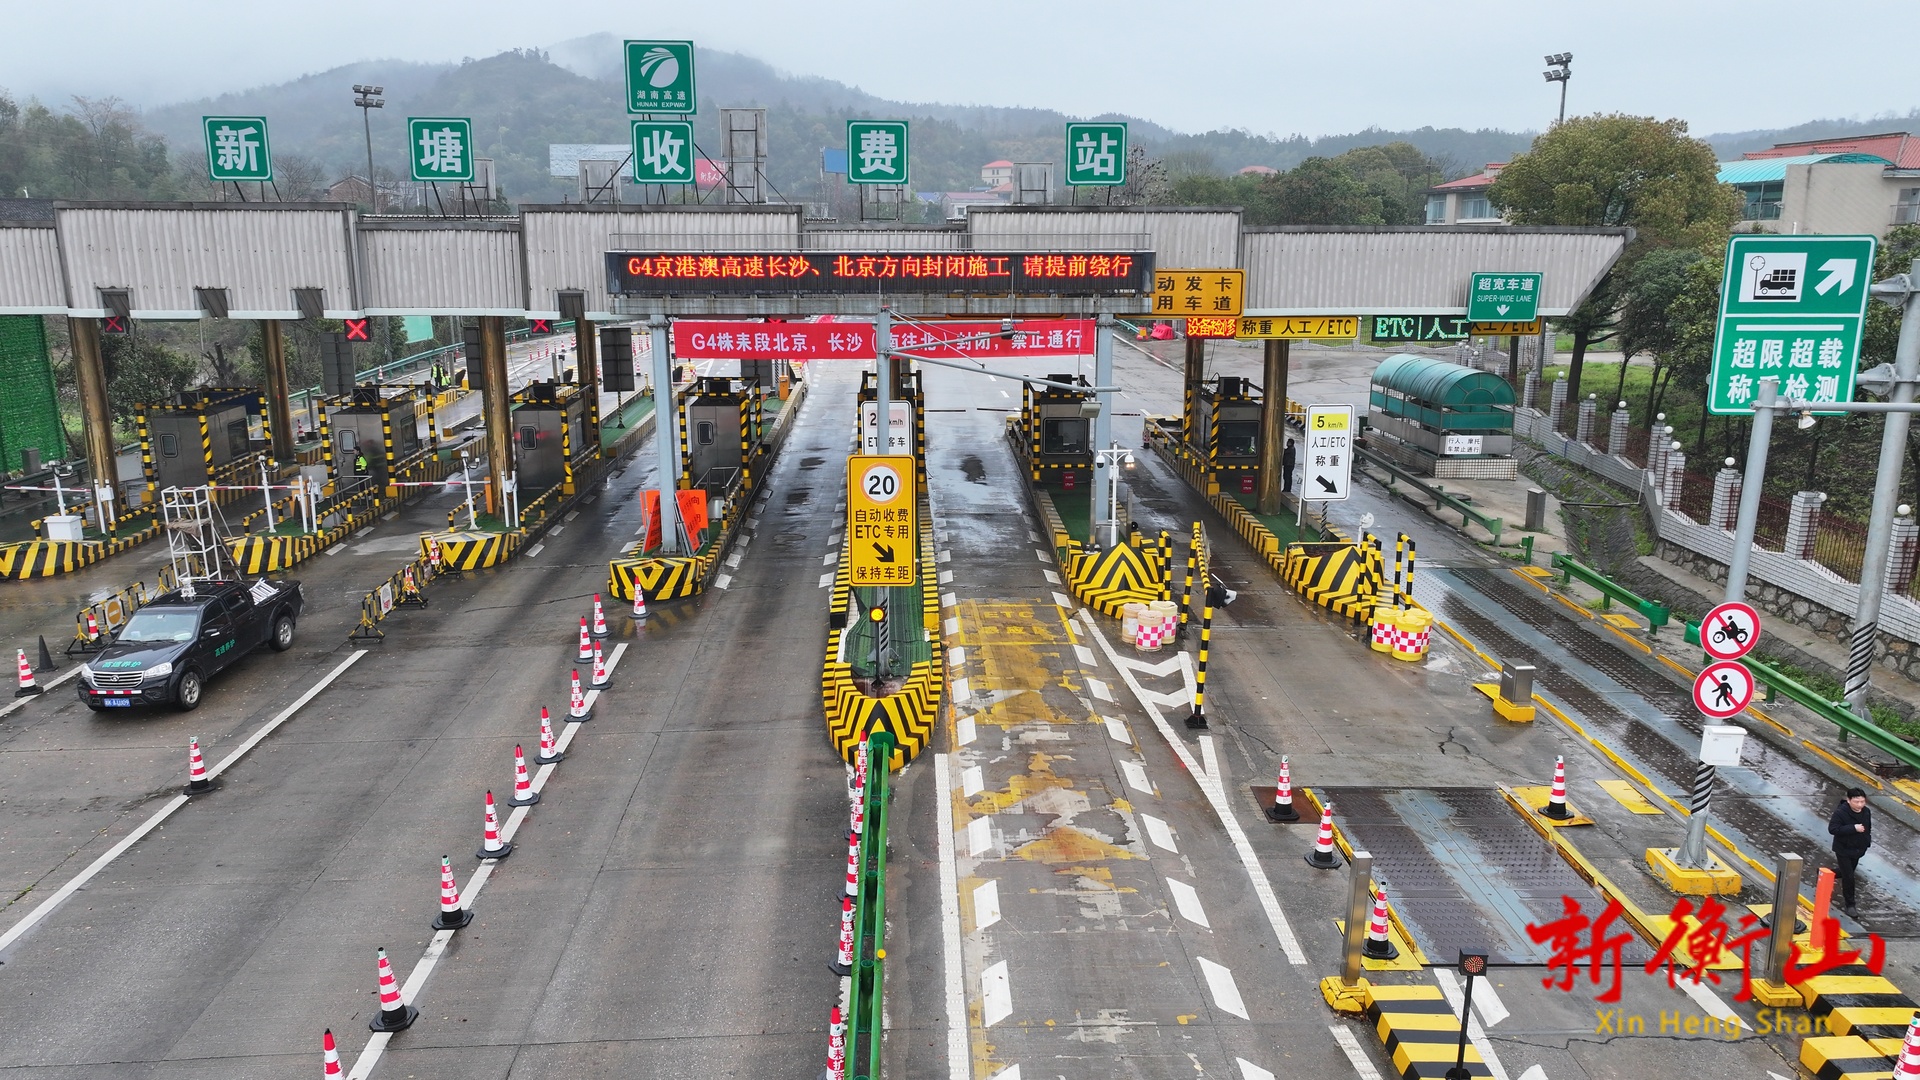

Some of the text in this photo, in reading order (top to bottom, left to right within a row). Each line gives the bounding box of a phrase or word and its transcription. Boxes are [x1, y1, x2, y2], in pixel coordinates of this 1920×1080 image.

[636, 90, 686, 100] 湖南高速
[215, 126, 260, 171] 新
[419, 127, 463, 173] 塘
[642, 130, 686, 175] 收
[858, 130, 897, 175] 费
[1075, 132, 1117, 176] 站
[1022, 255, 1133, 278] 请提前绕行
[1478, 278, 1534, 291] 超宽车道
[1241, 319, 1352, 335] 称重 人工/ETC
[1731, 338, 1844, 369] 超限超载
[1317, 416, 1325, 428] 5
[1312, 436, 1346, 448] 人工/ETC
[1315, 455, 1340, 467] 称重
[868, 475, 895, 495] 20
[855, 508, 909, 523] 自动收费
[856, 566, 909, 580] 保持车距
